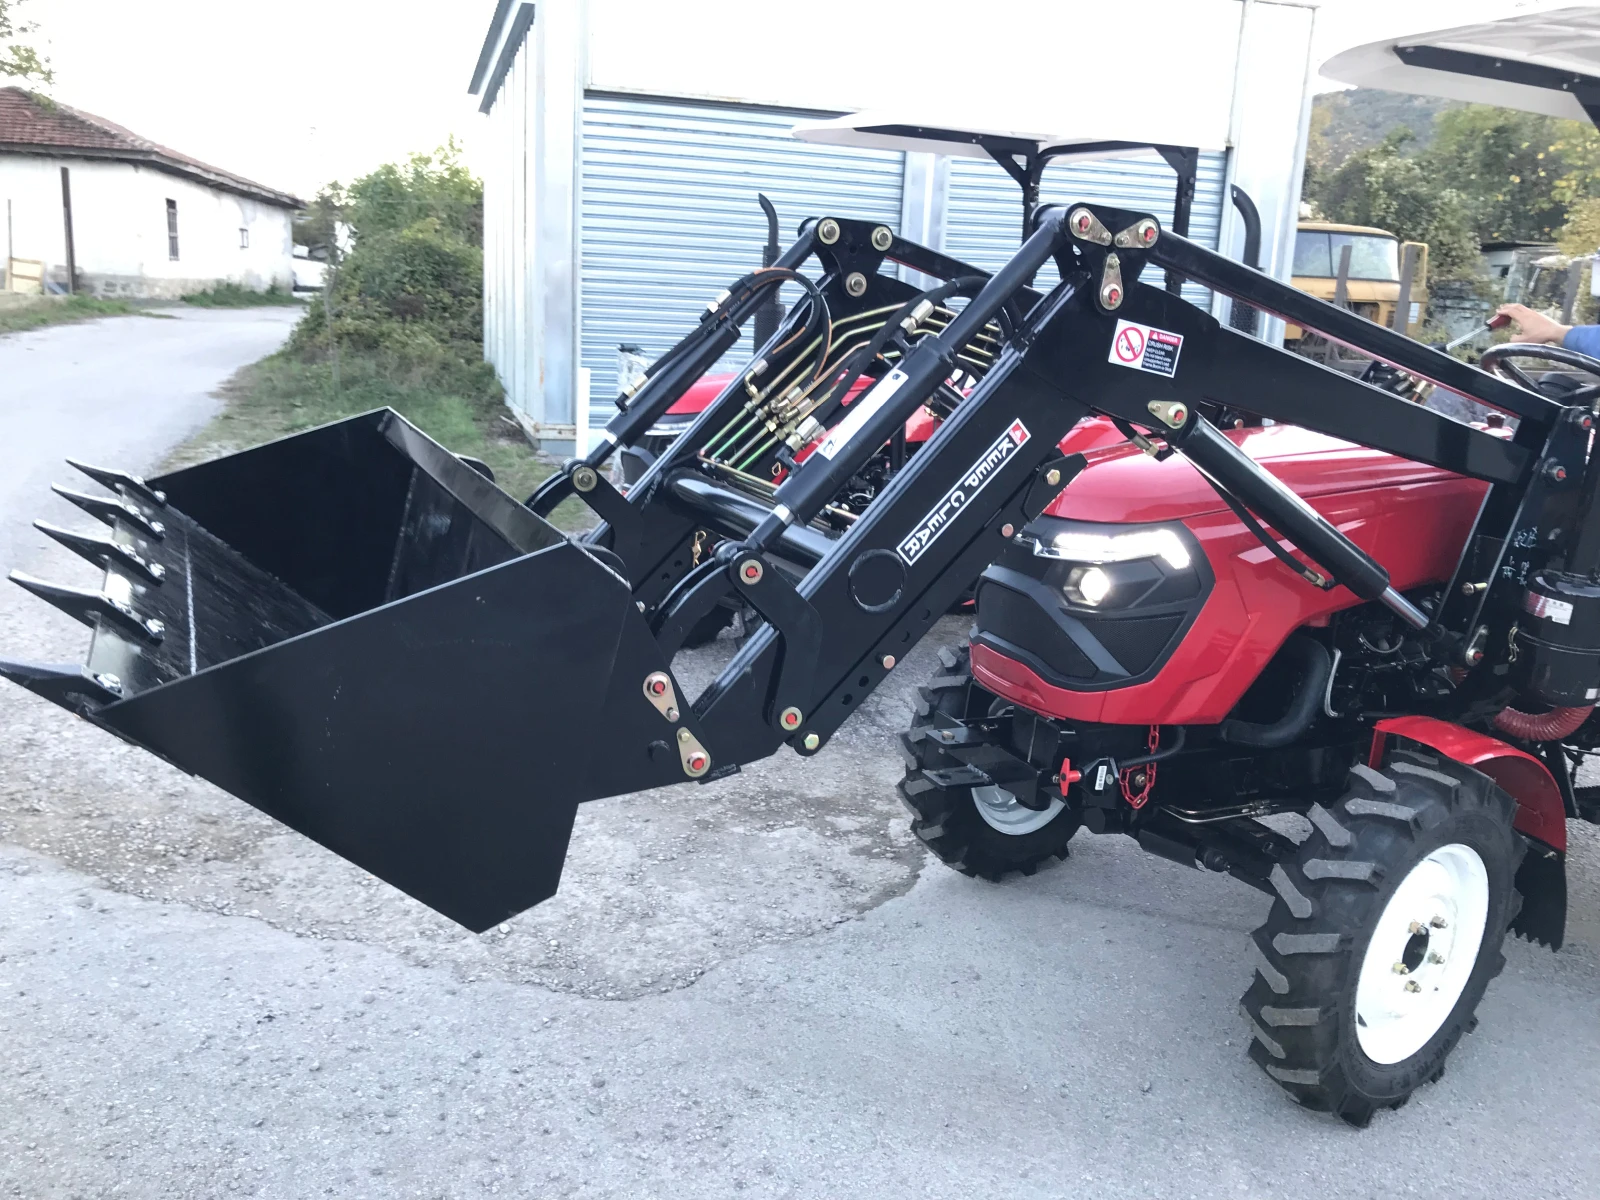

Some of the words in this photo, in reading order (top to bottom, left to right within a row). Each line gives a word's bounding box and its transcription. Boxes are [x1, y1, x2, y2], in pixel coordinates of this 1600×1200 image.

[1159, 333, 1178, 343] DANGER
[964, 437, 1014, 488] KEEP
[904, 490, 965, 557] CLEAR
